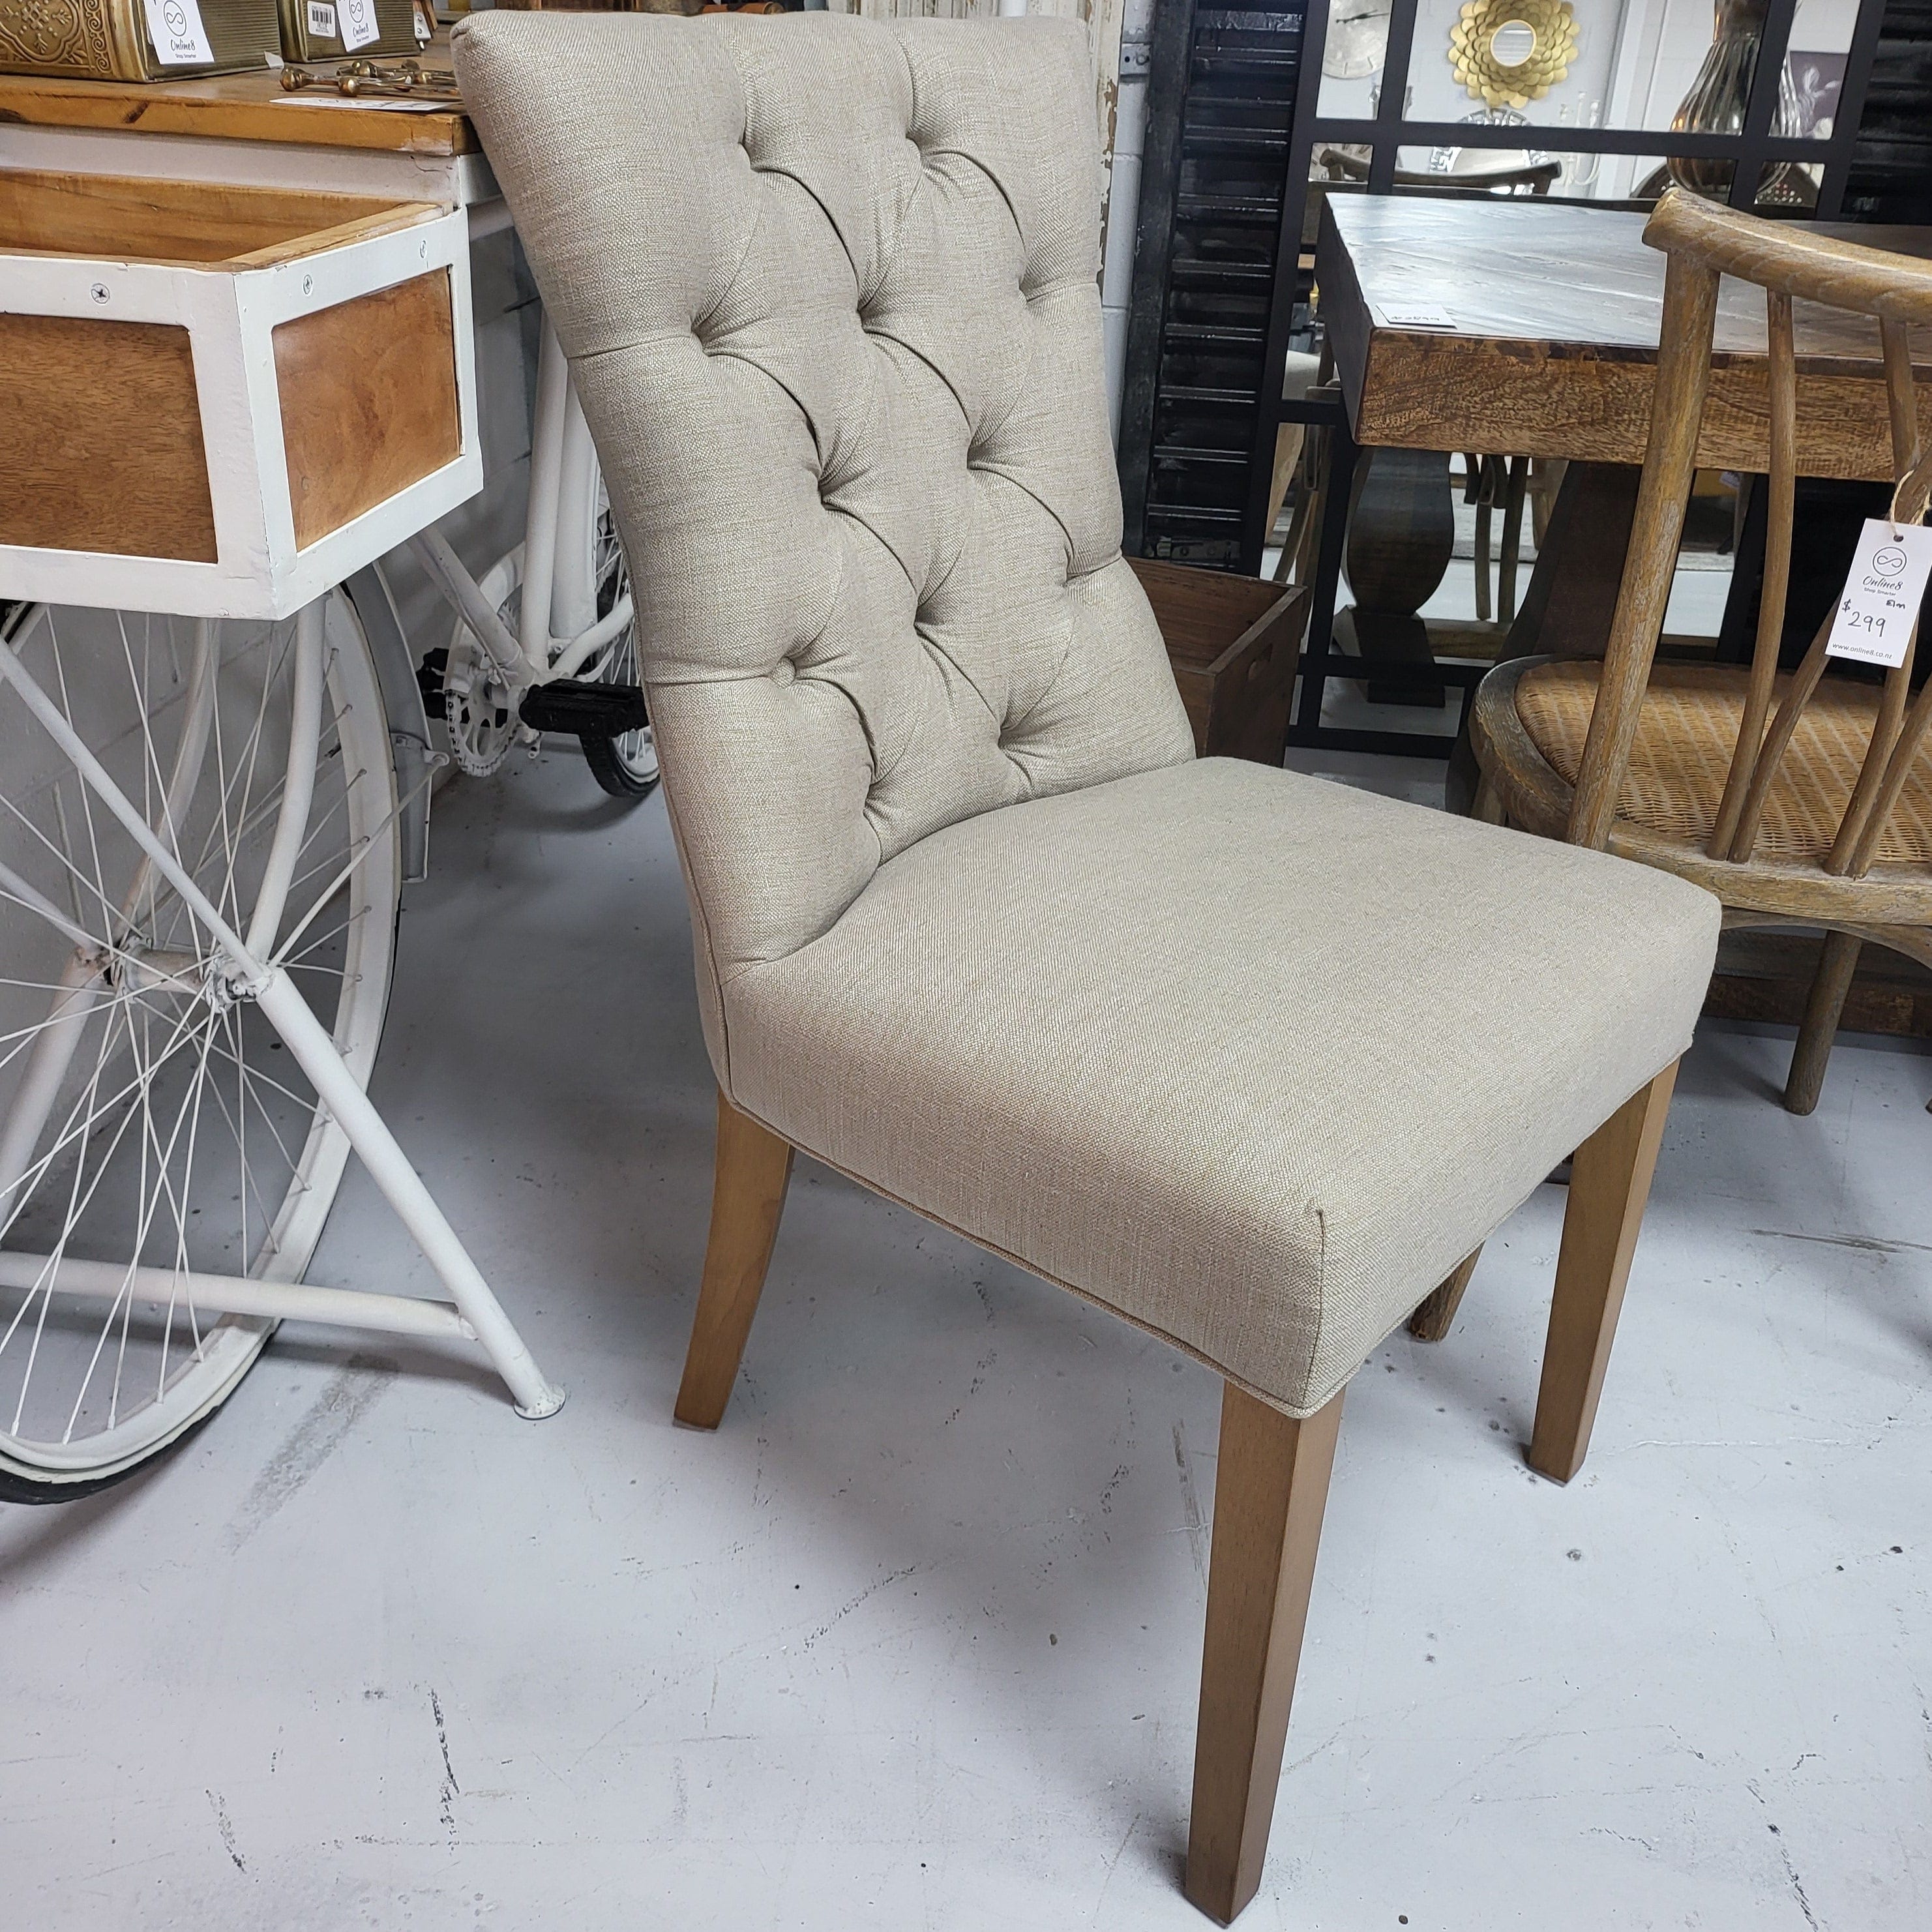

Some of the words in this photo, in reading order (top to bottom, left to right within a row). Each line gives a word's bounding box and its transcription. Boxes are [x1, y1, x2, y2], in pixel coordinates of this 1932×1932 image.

[170, 38, 196, 51] Online8
[1862, 576, 1903, 591] Online8
[1832, 642, 1893, 660] www.online8.co.nz
